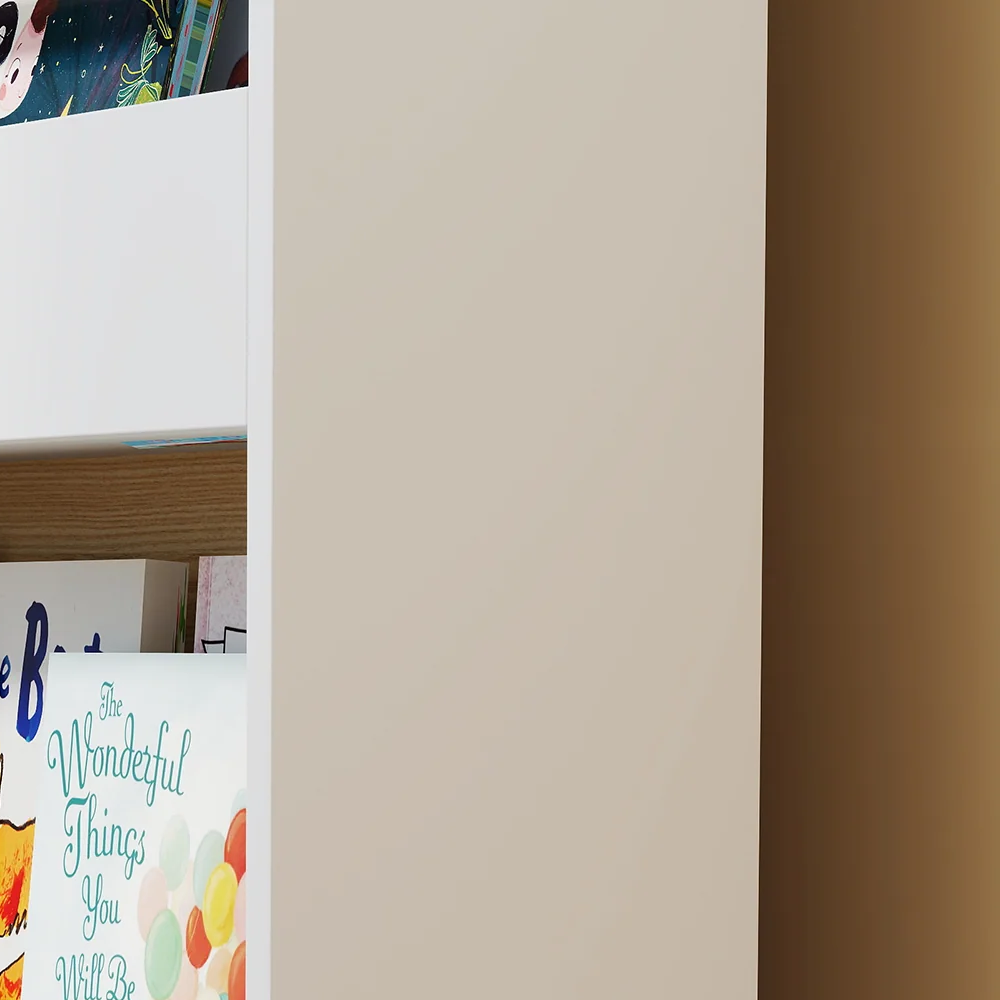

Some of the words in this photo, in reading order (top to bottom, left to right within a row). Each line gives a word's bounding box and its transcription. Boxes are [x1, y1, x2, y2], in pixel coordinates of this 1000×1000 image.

[99, 681, 123, 720] The
[47, 711, 192, 807] Wonderful
[63, 792, 146, 880] Things
[81, 873, 122, 941] You
